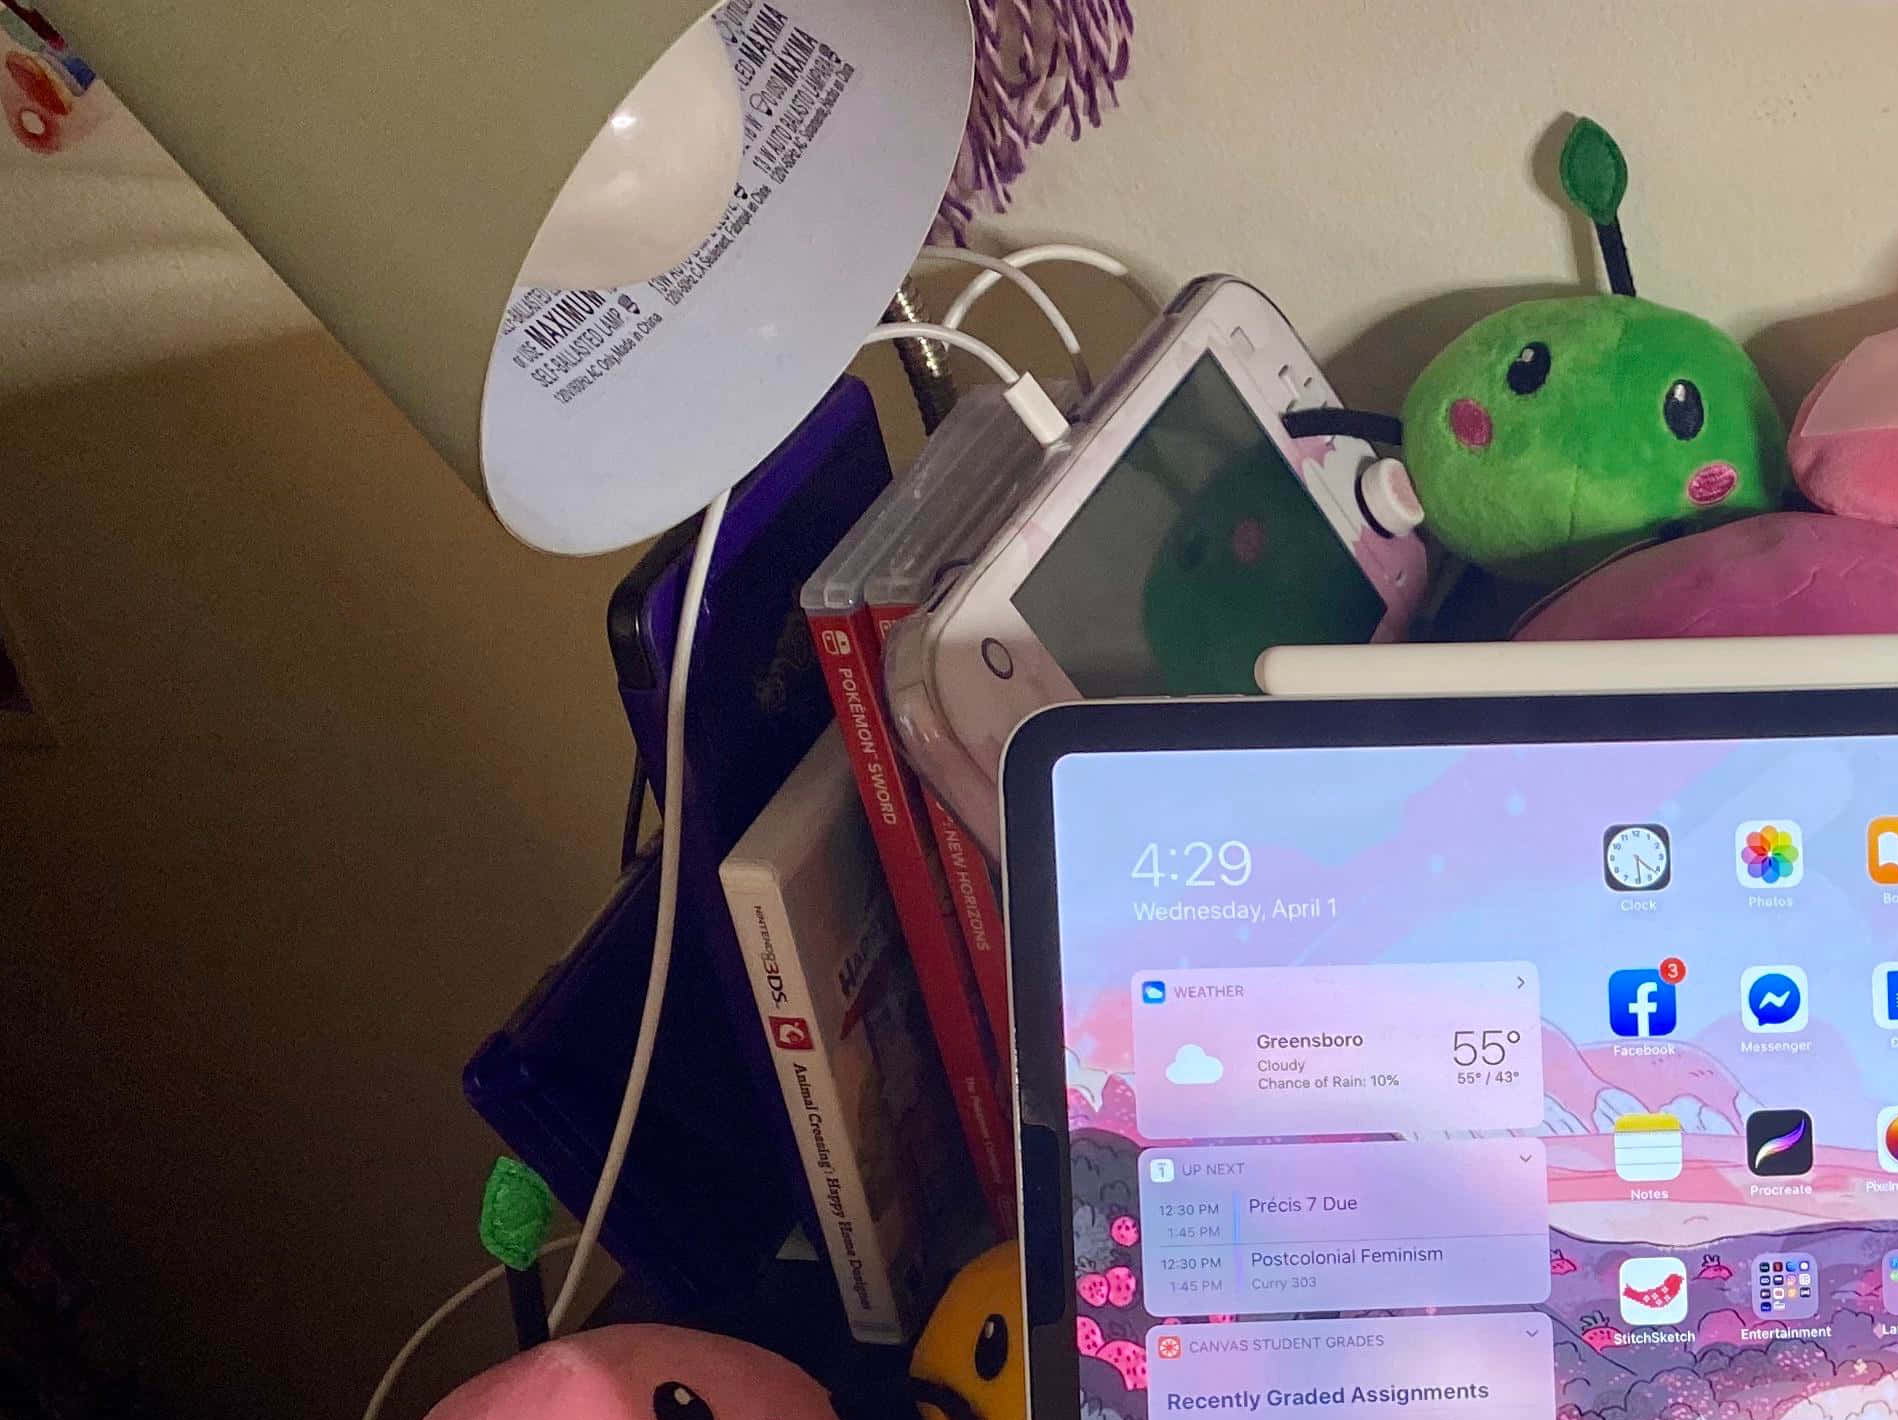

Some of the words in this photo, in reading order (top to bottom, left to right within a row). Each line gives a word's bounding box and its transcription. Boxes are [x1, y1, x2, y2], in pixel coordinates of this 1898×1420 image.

[771, 26, 819, 88] MÁXIMA
[524, 291, 606, 351] MAXIMUM
[637, 313, 663, 335] China
[531, 328, 605, 388] SELF-BALLASTED
[598, 307, 625, 336] LAMP
[838, 668, 876, 755] POKÉMON
[868, 763, 896, 825] SWORD
[1131, 841, 1251, 887] 4:29
[944, 829, 968, 867] NEW
[958, 872, 991, 951] HORIZONS
[1621, 900, 1656, 911] Clock
[1749, 896, 1792, 907] Photos
[1133, 901, 1265, 922] Wednesday,
[1272, 899, 1320, 920] April
[1668, 963, 1678, 978] 3
[765, 962, 789, 1009] 3DS
[1174, 985, 1243, 999] WEATHER
[1257, 1032, 1363, 1049] Greensboro
[1741, 1042, 1811, 1053] Messenger
[1454, 1031, 1520, 1066] 55°
[1614, 1042, 1675, 1056] Facebook
[1258, 1059, 1305, 1073] Cloudy
[1258, 1078, 1310, 1089] Chance
[1315, 1076, 1328, 1088] of
[1332, 1074, 1366, 1088] Rain:
[1371, 1075, 1399, 1086] 10%
[1458, 1072, 1481, 1084] 55°
[1495, 1071, 1519, 1083] 43°
[1183, 1164, 1201, 1176] UP
[1207, 1162, 1244, 1175] NEXT
[793, 1063, 818, 1112] Animal
[826, 1177, 846, 1221] Happy
[838, 1219, 857, 1259] Home
[849, 1259, 872, 1311] Designer
[1631, 1189, 1668, 1200] Notes
[1751, 1185, 1812, 1196] Procreate
[1160, 1205, 1194, 1216] 12:30
[1199, 1204, 1218, 1214] PM
[1249, 1195, 1302, 1213] Précis
[1307, 1197, 1316, 1211] 7
[1324, 1197, 1357, 1210] Due
[1168, 1227, 1195, 1238] 1:45
[1200, 1226, 1220, 1237] PM
[1161, 1258, 1196, 1270] 12:30
[1201, 1258, 1221, 1268] PM
[1252, 1250, 1355, 1266] Postcolonial
[1362, 1249, 1442, 1263] Feminism
[1170, 1281, 1197, 1291] 1:45
[1202, 1280, 1222, 1291] PM
[1252, 1278, 1287, 1291] Curry
[1292, 1277, 1316, 1288] 303
[1614, 1331, 1695, 1345] StitchSketch
[1741, 1326, 1832, 1340] Entertainment
[1190, 1340, 1248, 1353] CANVAS
[1253, 1337, 1320, 1351] STUDENT
[1326, 1335, 1384, 1348] GRADES
[1168, 1391, 1260, 1411] Recently
[1267, 1388, 1344, 1406] Graded
[1352, 1384, 1489, 1408] Assignments
